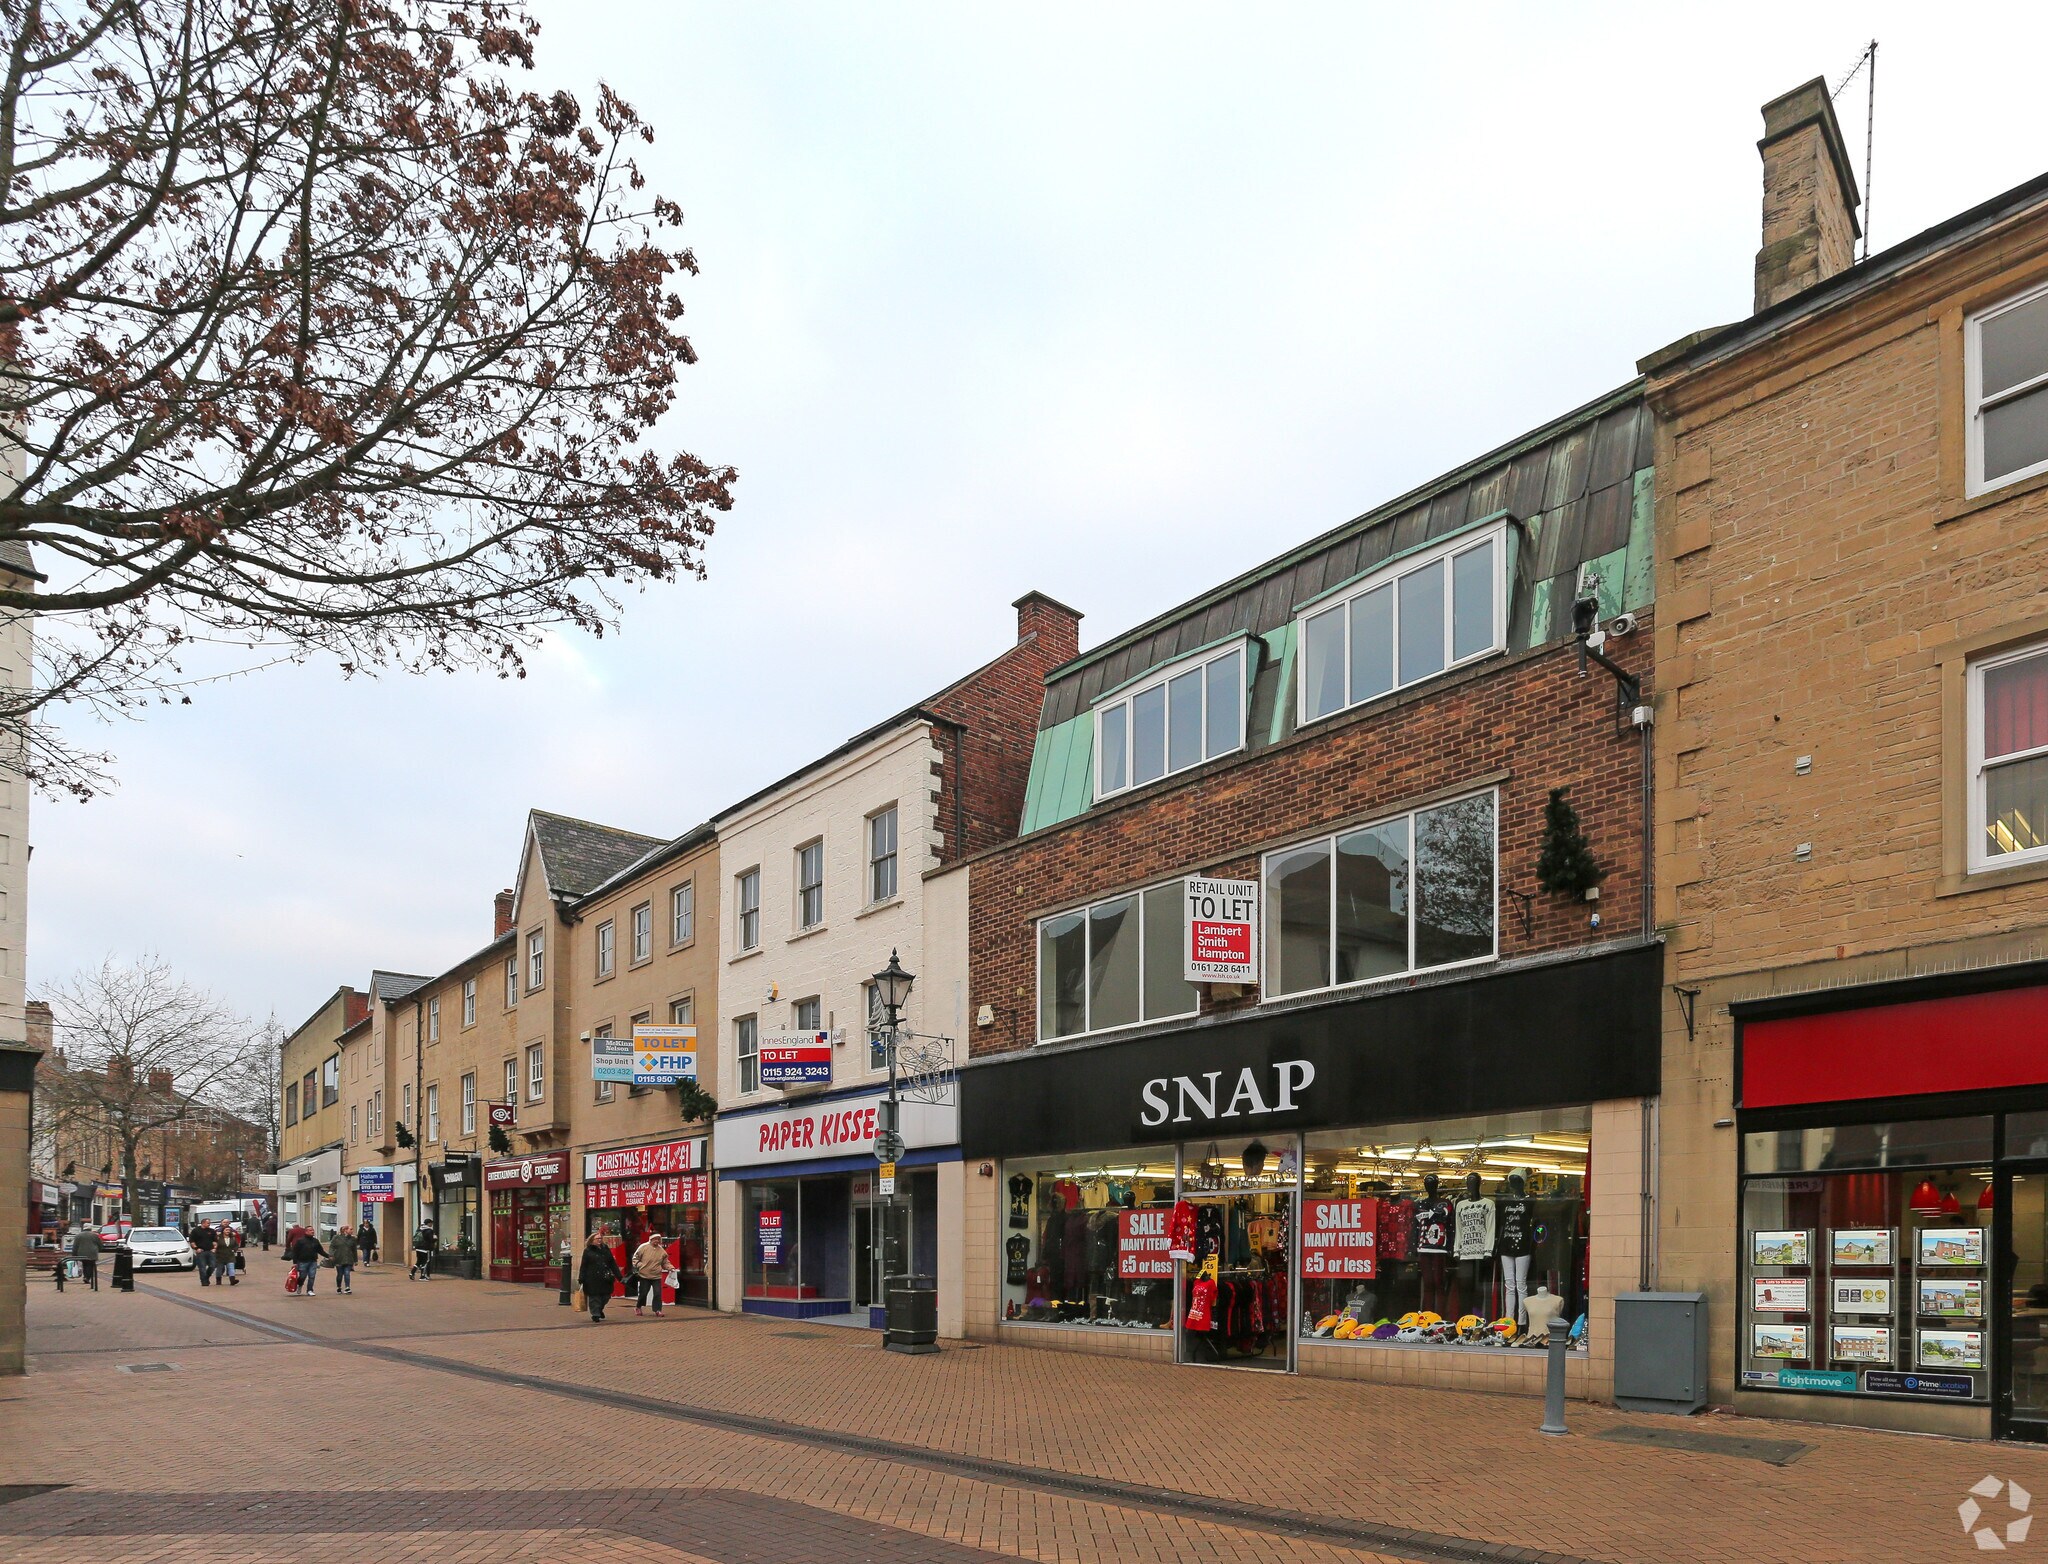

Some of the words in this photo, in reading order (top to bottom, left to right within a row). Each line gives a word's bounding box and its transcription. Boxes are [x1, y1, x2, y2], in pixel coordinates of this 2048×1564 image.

[1190, 882, 1224, 894] RETAIL
[1228, 884, 1253, 896] UNIT
[1190, 896, 1215, 918] TO
[1222, 898, 1253, 920] LET
[1198, 924, 1242, 936] Lambert
[1198, 936, 1228, 947] Smith
[1198, 947, 1244, 960] Hampton
[1191, 962, 1210, 971] 0161
[1213, 964, 1229, 972] 228
[1231, 964, 1250, 973] 6411
[642, 1038, 660, 1048] TO
[664, 1039, 688, 1048] LET
[763, 1051, 776, 1060] TO
[780, 1051, 798, 1060] LET
[660, 1056, 692, 1069] FHP
[763, 1068, 782, 1076] 0115
[785, 1068, 802, 1076] 924
[805, 1067, 828, 1075] 3243
[1140, 1060, 1315, 1126] SNAP
[759, 1117, 814, 1152] PAPER
[597, 1150, 639, 1170] CHRISTMAS
[642, 1150, 650, 1172] £1
[660, 1146, 670, 1171] £1
[679, 1144, 689, 1169] £1
[534, 1164, 559, 1176] EXCHANGE
[621, 1179, 649, 1190] CHRISTMAS
[656, 1179, 666, 1203] £1
[761, 1217, 769, 1225] TO
[770, 1217, 780, 1225] LET
[1316, 1204, 1361, 1229] SALE
[1130, 1213, 1164, 1236] SALE
[1121, 1238, 1145, 1250] MANY
[1305, 1232, 1336, 1247] MANY
[1338, 1232, 1374, 1247] ITEMS
[1122, 1255, 1136, 1273] £5
[1139, 1262, 1150, 1273] or
[1151, 1260, 1172, 1273] less
[1306, 1252, 1324, 1273] £5
[1328, 1260, 1342, 1273] or
[1344, 1257, 1372, 1273] less
[1782, 1376, 1842, 1386] rightmove
[1918, 1380, 1968, 1389] PrimeLocation
